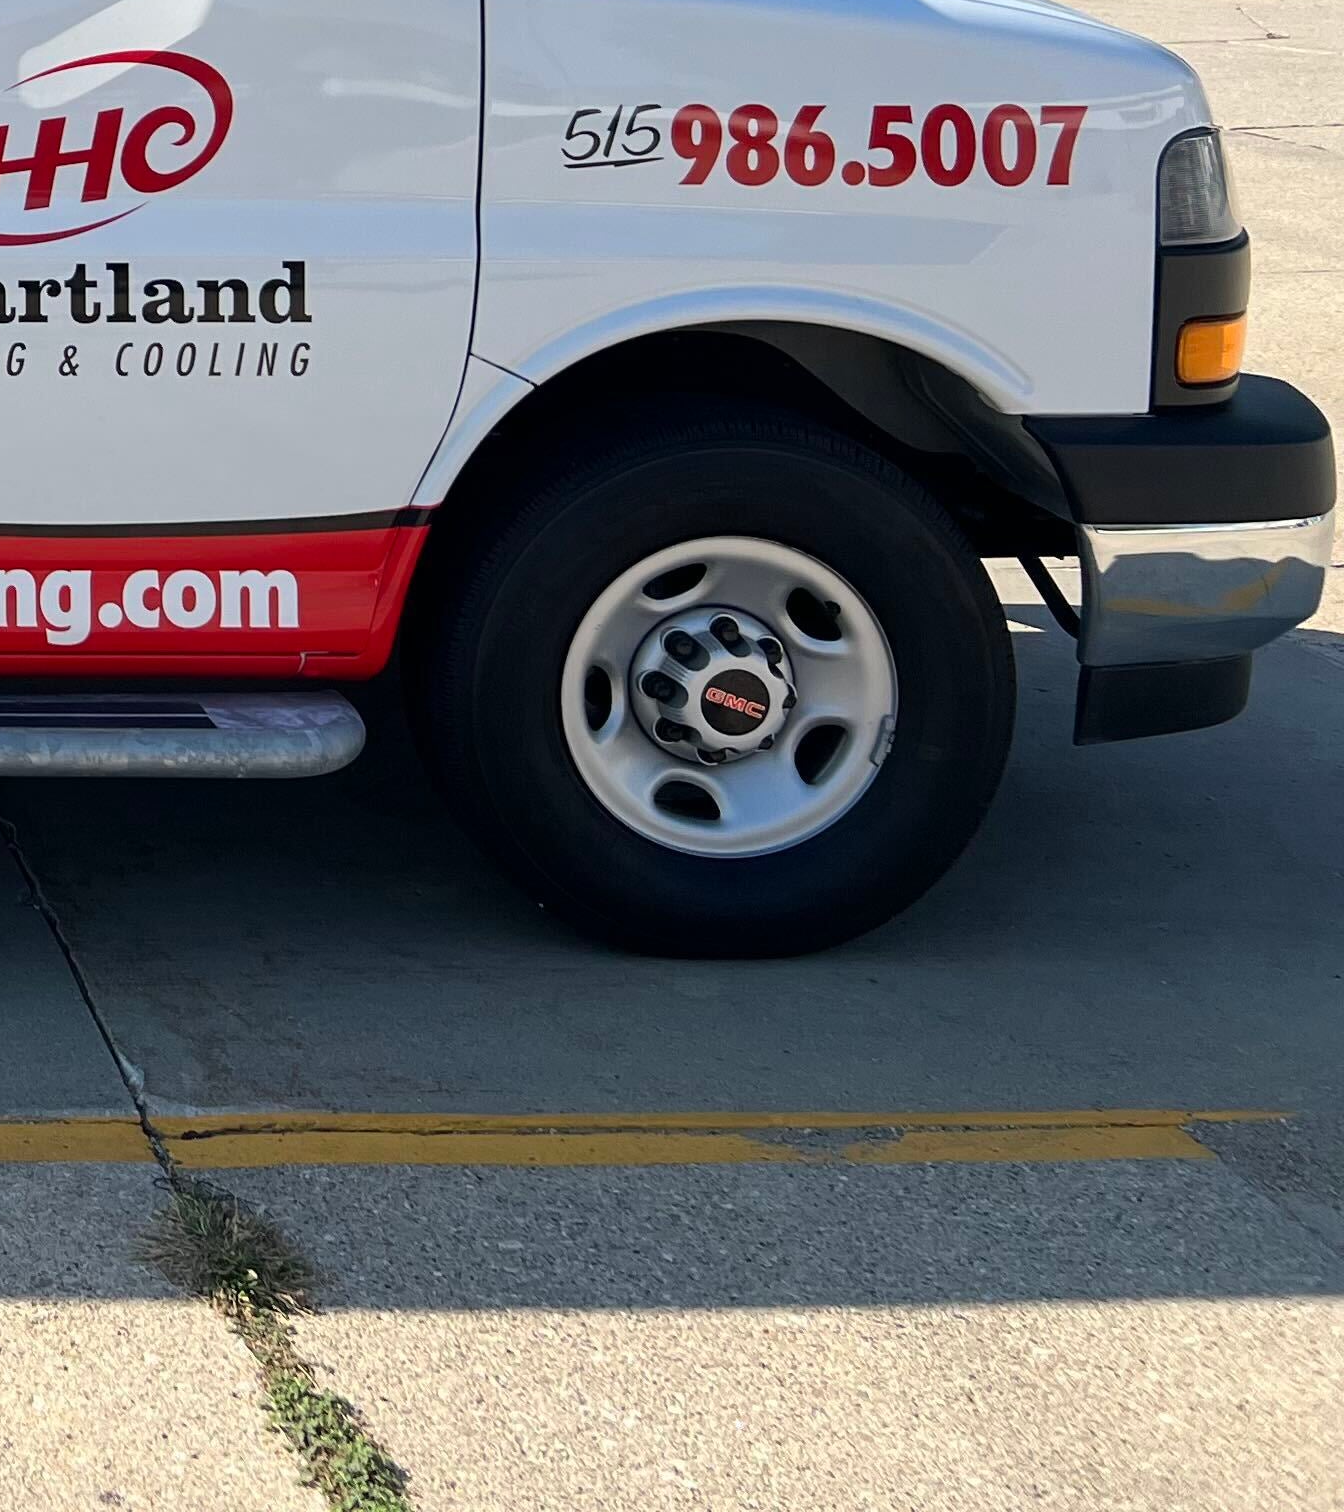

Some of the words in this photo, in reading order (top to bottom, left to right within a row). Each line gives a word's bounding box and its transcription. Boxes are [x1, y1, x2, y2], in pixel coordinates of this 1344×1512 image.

[561, 103, 664, 169] 515
[671, 103, 1089, 187] 986.5007
[58, 344, 81, 377] &
[115, 341, 313, 377] COOLING
[704, 687, 766, 720] GMC
